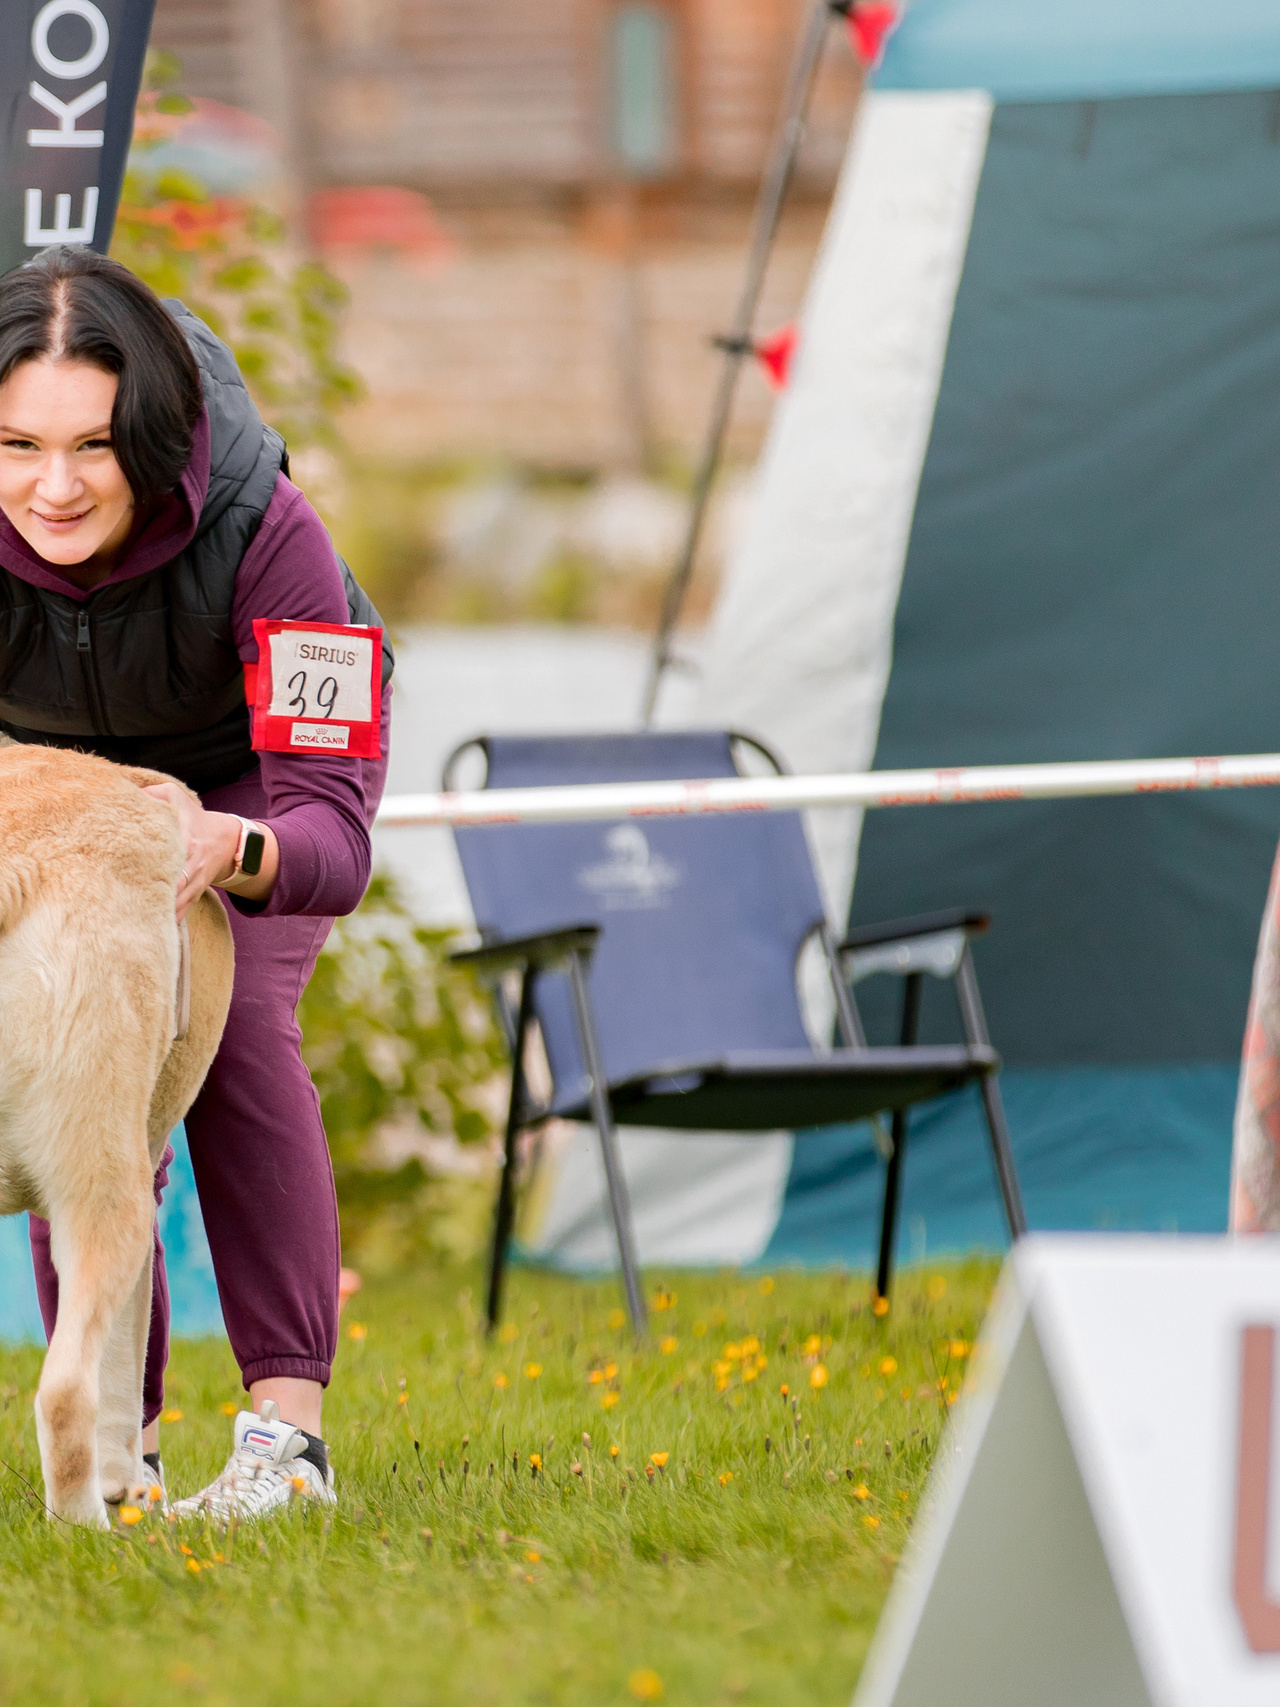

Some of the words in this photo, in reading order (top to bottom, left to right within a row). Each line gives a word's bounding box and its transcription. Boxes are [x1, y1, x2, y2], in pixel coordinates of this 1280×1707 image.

[299, 644, 356, 666] SIRIUS
[287, 670, 339, 719] 39
[294, 734, 320, 743] ROYAL
[321, 735, 346, 745] CANIN
